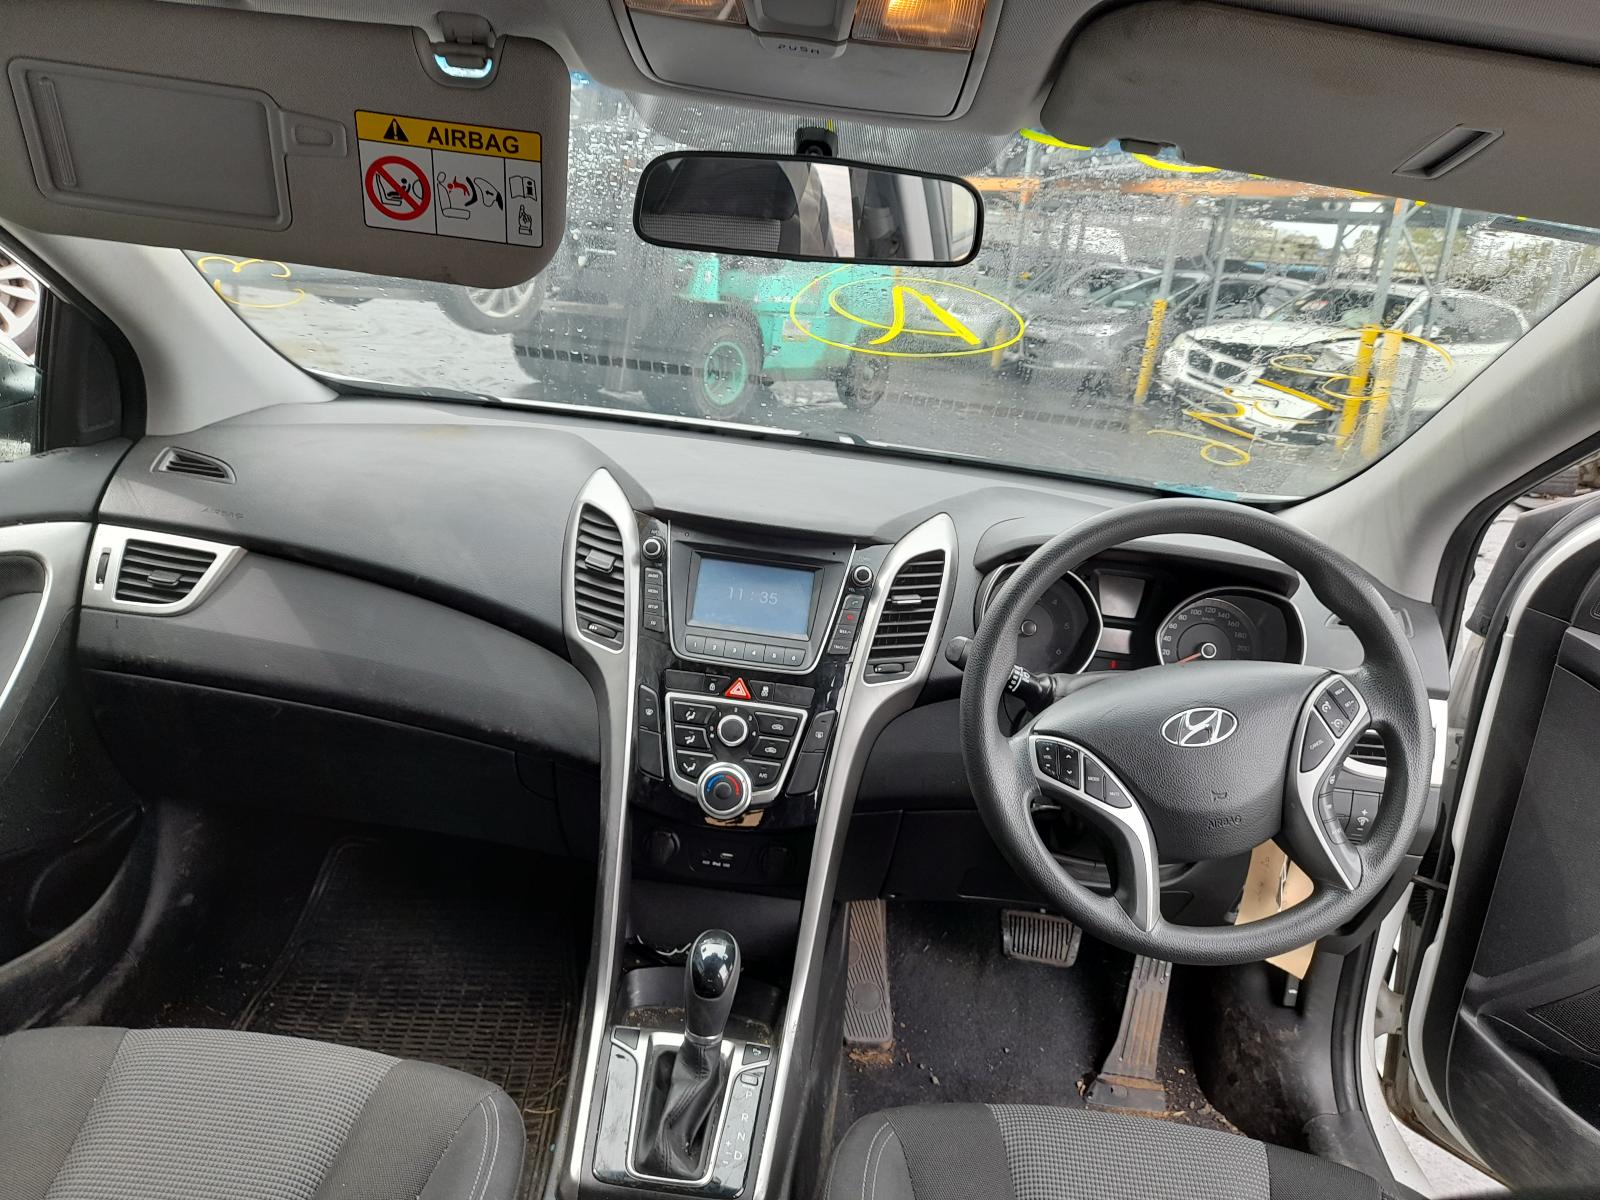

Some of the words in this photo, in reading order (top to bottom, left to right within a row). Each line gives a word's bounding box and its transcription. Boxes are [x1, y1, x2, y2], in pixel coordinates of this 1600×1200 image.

[777, 43, 821, 55] PUSH
[427, 126, 520, 154] AIRBAG
[1190, 608, 1202, 616] 100
[1217, 611, 1230, 620] 140
[1227, 619, 1240, 628] 160
[1162, 648, 1170, 656] 20
[745, 1090, 753, 1099] P
[741, 1112, 749, 1121] R
[737, 1132, 746, 1141] N
[733, 1150, 743, 1160] D
